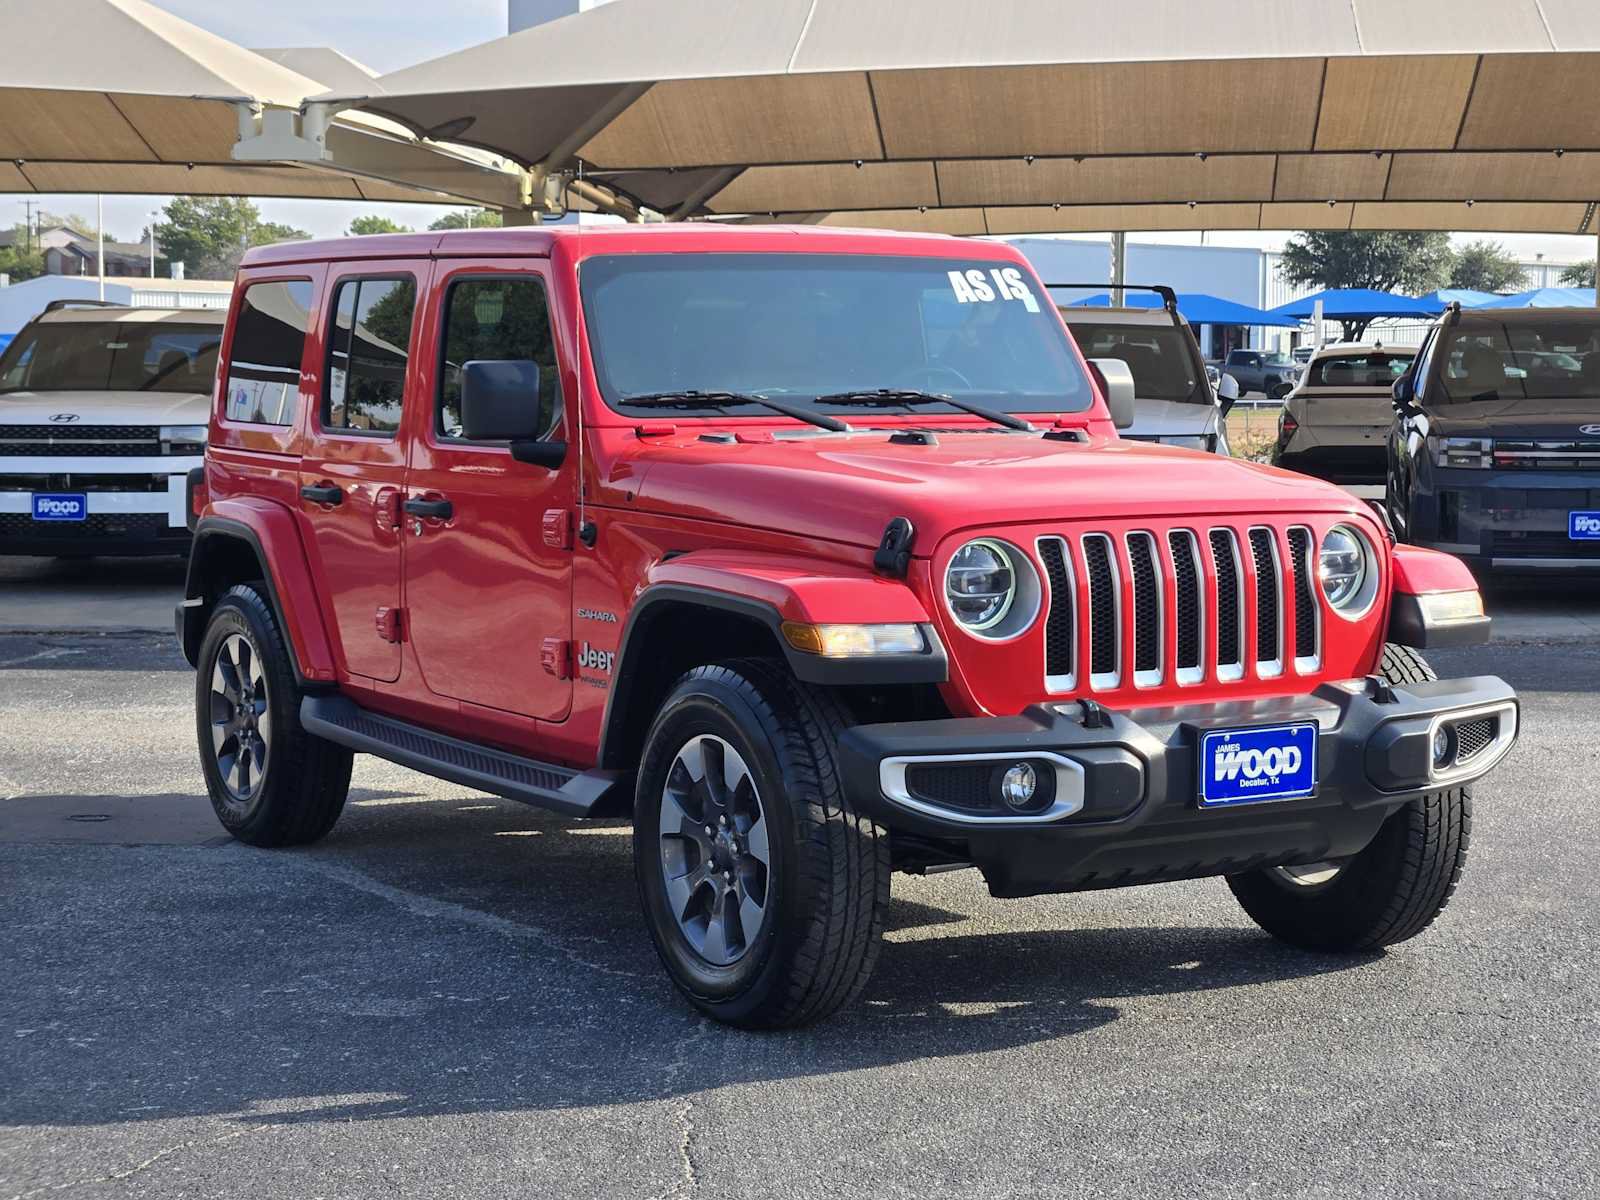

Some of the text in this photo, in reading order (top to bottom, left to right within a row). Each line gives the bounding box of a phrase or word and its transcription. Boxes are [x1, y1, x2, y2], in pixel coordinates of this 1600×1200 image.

[947, 267, 1032, 303] AS IS
[38, 500, 80, 513] WOOD
[577, 608, 617, 622] SAHARA
[577, 641, 616, 676] Jeep
[1215, 743, 1241, 754] JAMES
[1215, 746, 1302, 781] WOOD
[1240, 776, 1280, 788] Decatur, Tx
